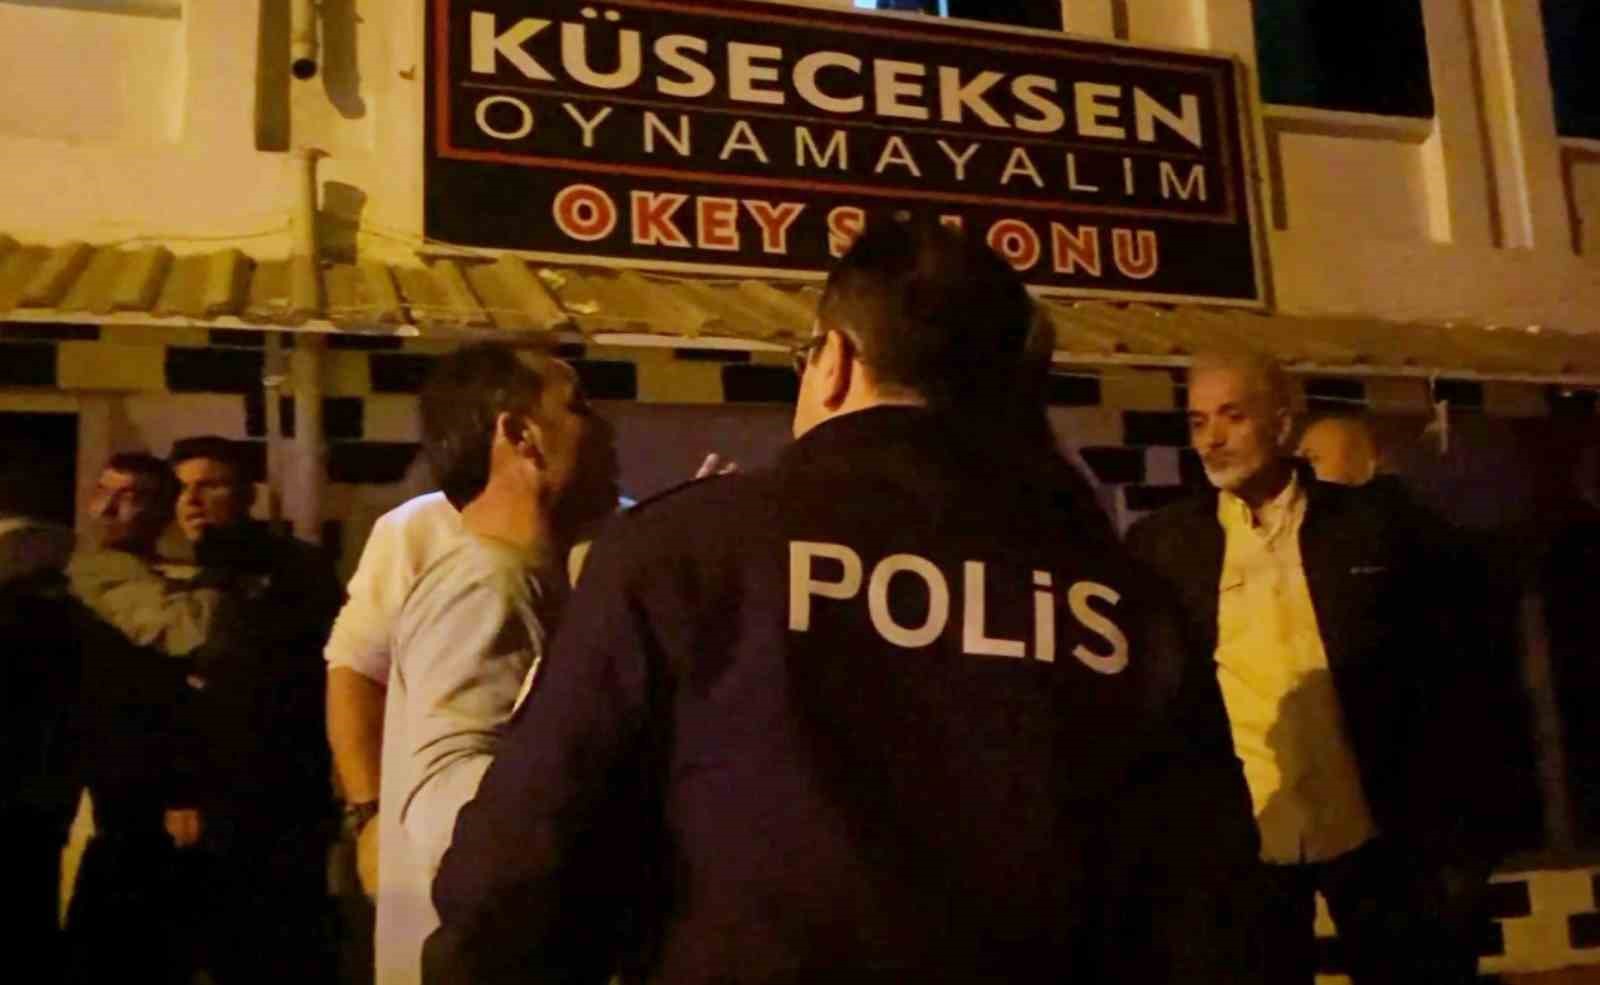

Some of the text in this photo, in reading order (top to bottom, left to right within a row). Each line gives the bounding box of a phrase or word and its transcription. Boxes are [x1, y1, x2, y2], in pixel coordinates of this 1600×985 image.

[470, 8, 1202, 148] KÜSECEKSEN
[475, 96, 1207, 201] OYNAMAYALIM
[553, 184, 1159, 280] OKEY SONU
